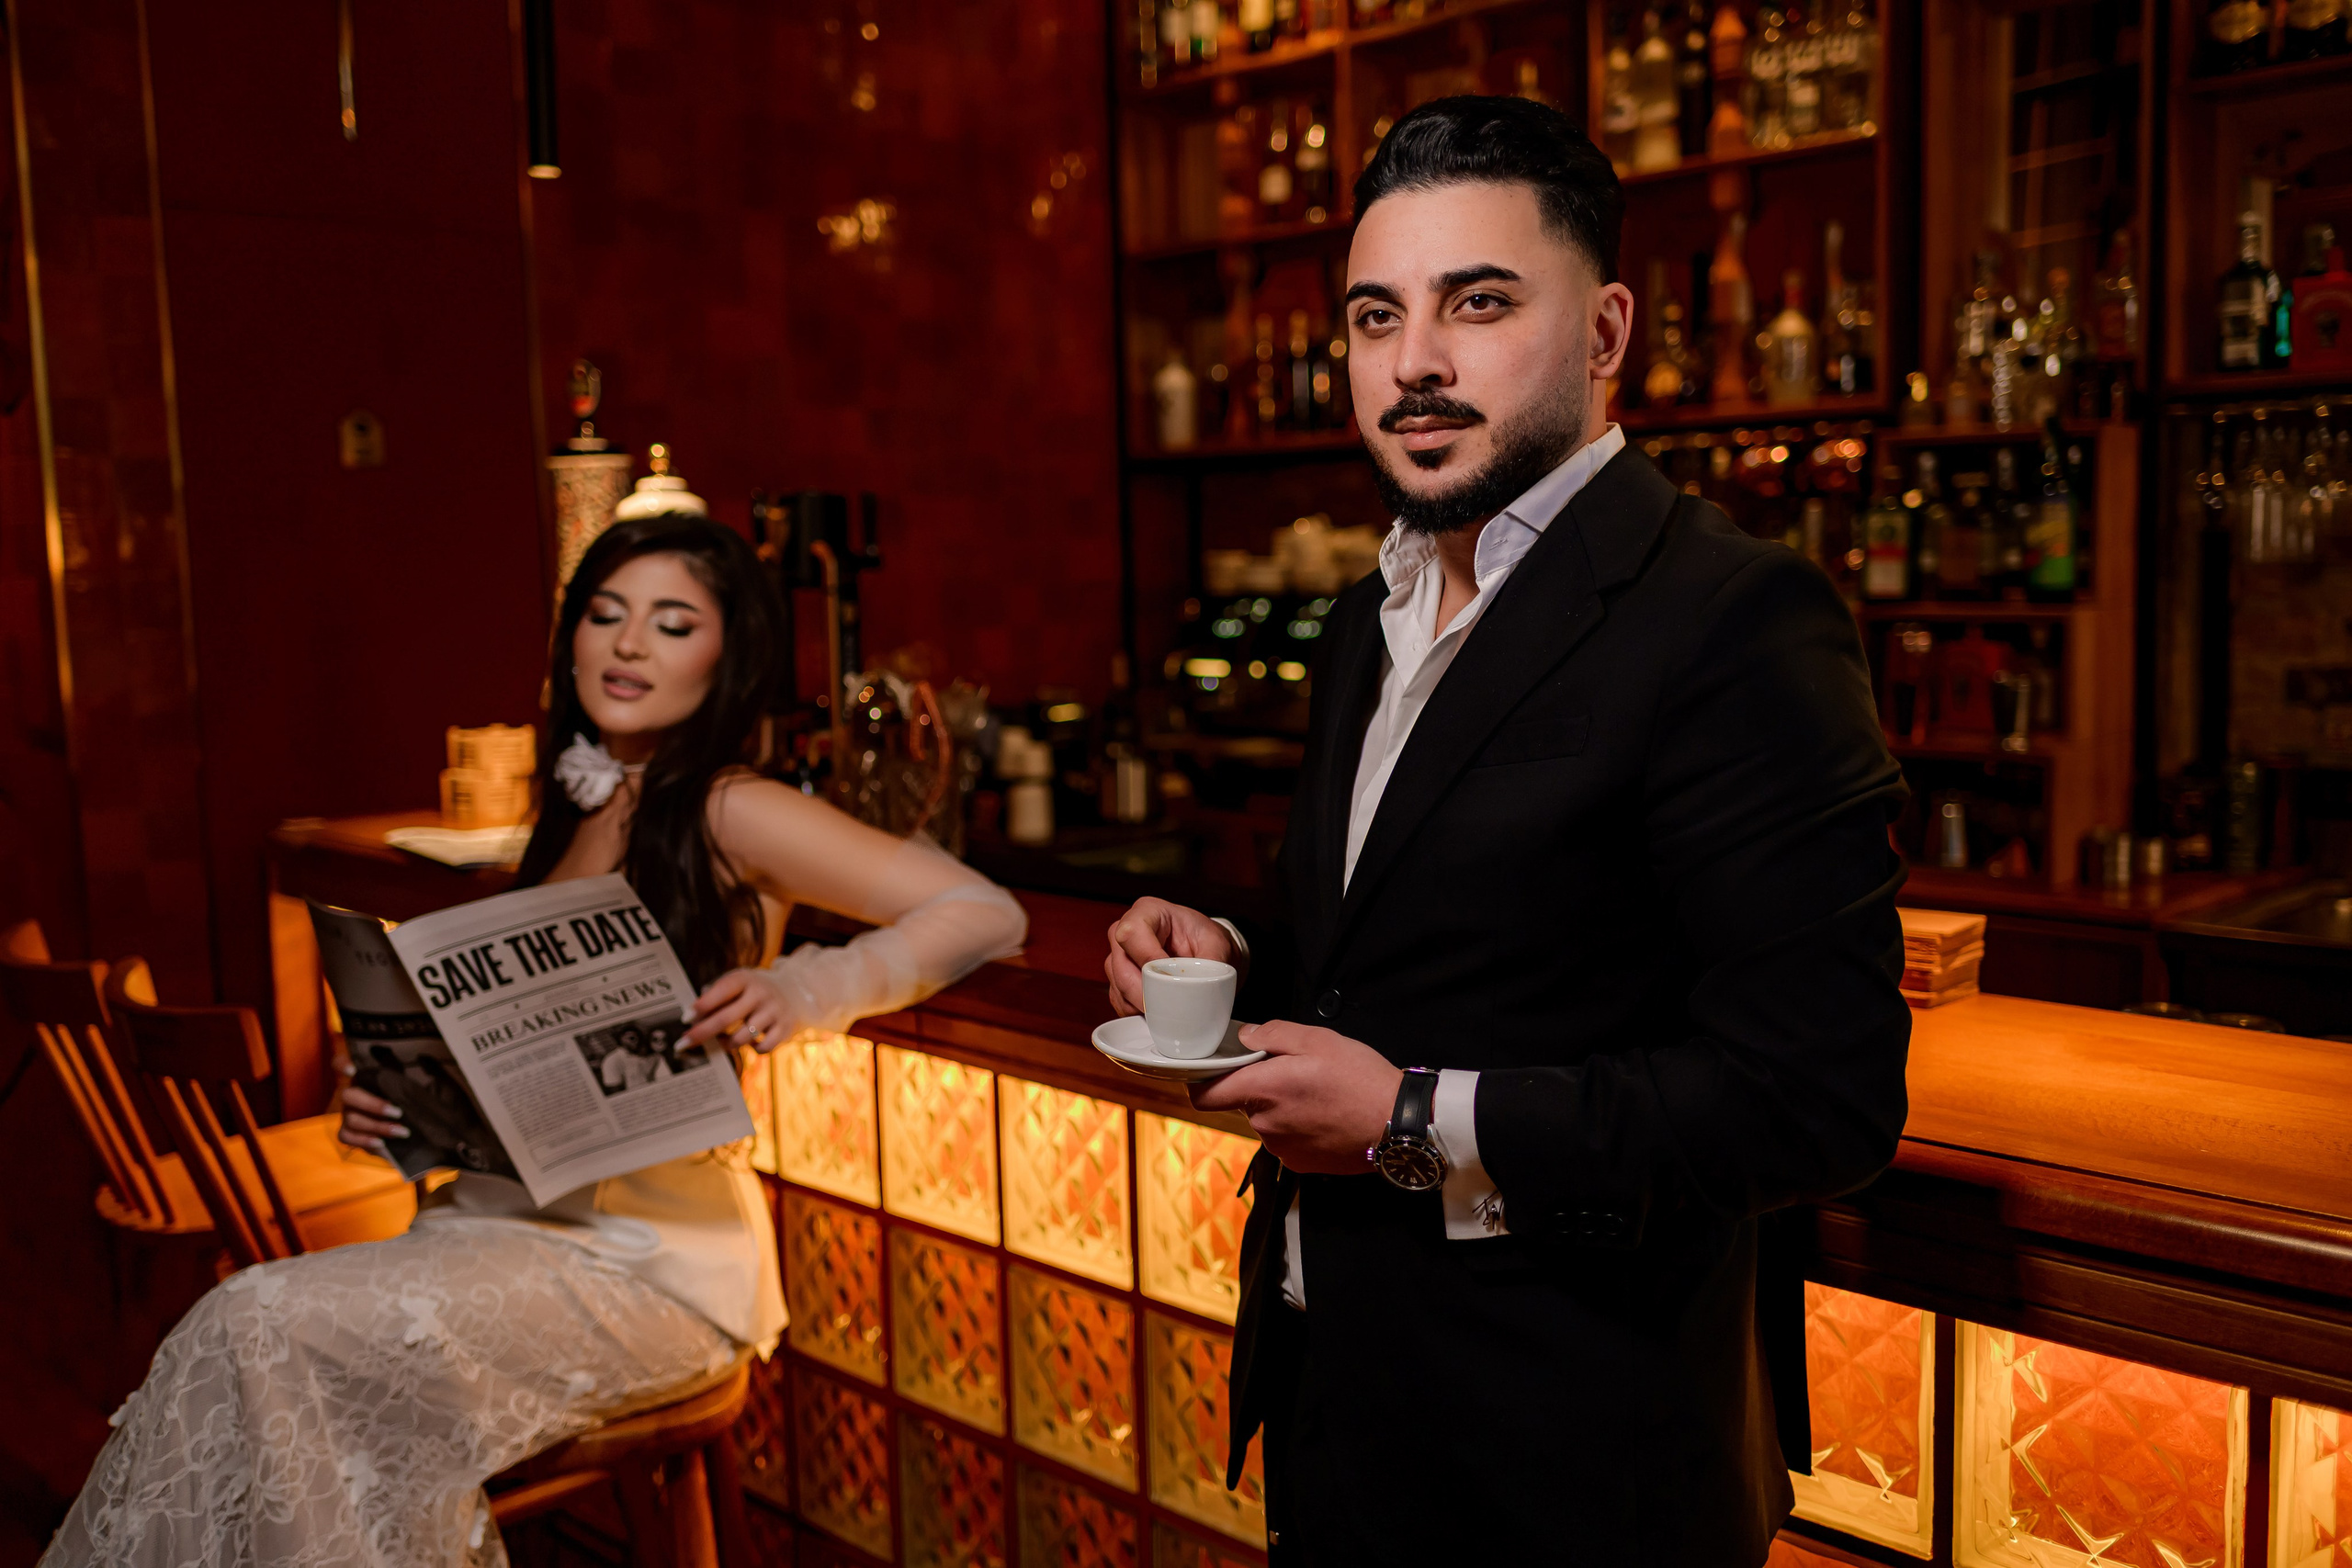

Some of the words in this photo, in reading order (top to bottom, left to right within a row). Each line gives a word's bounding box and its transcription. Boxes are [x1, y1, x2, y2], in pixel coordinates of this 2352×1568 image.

[417, 942, 514, 1009] SAVE
[504, 925, 577, 977] THE
[570, 906, 662, 959] DATE
[470, 998, 599, 1053] BREAKING
[602, 975, 673, 1007] NEWS
